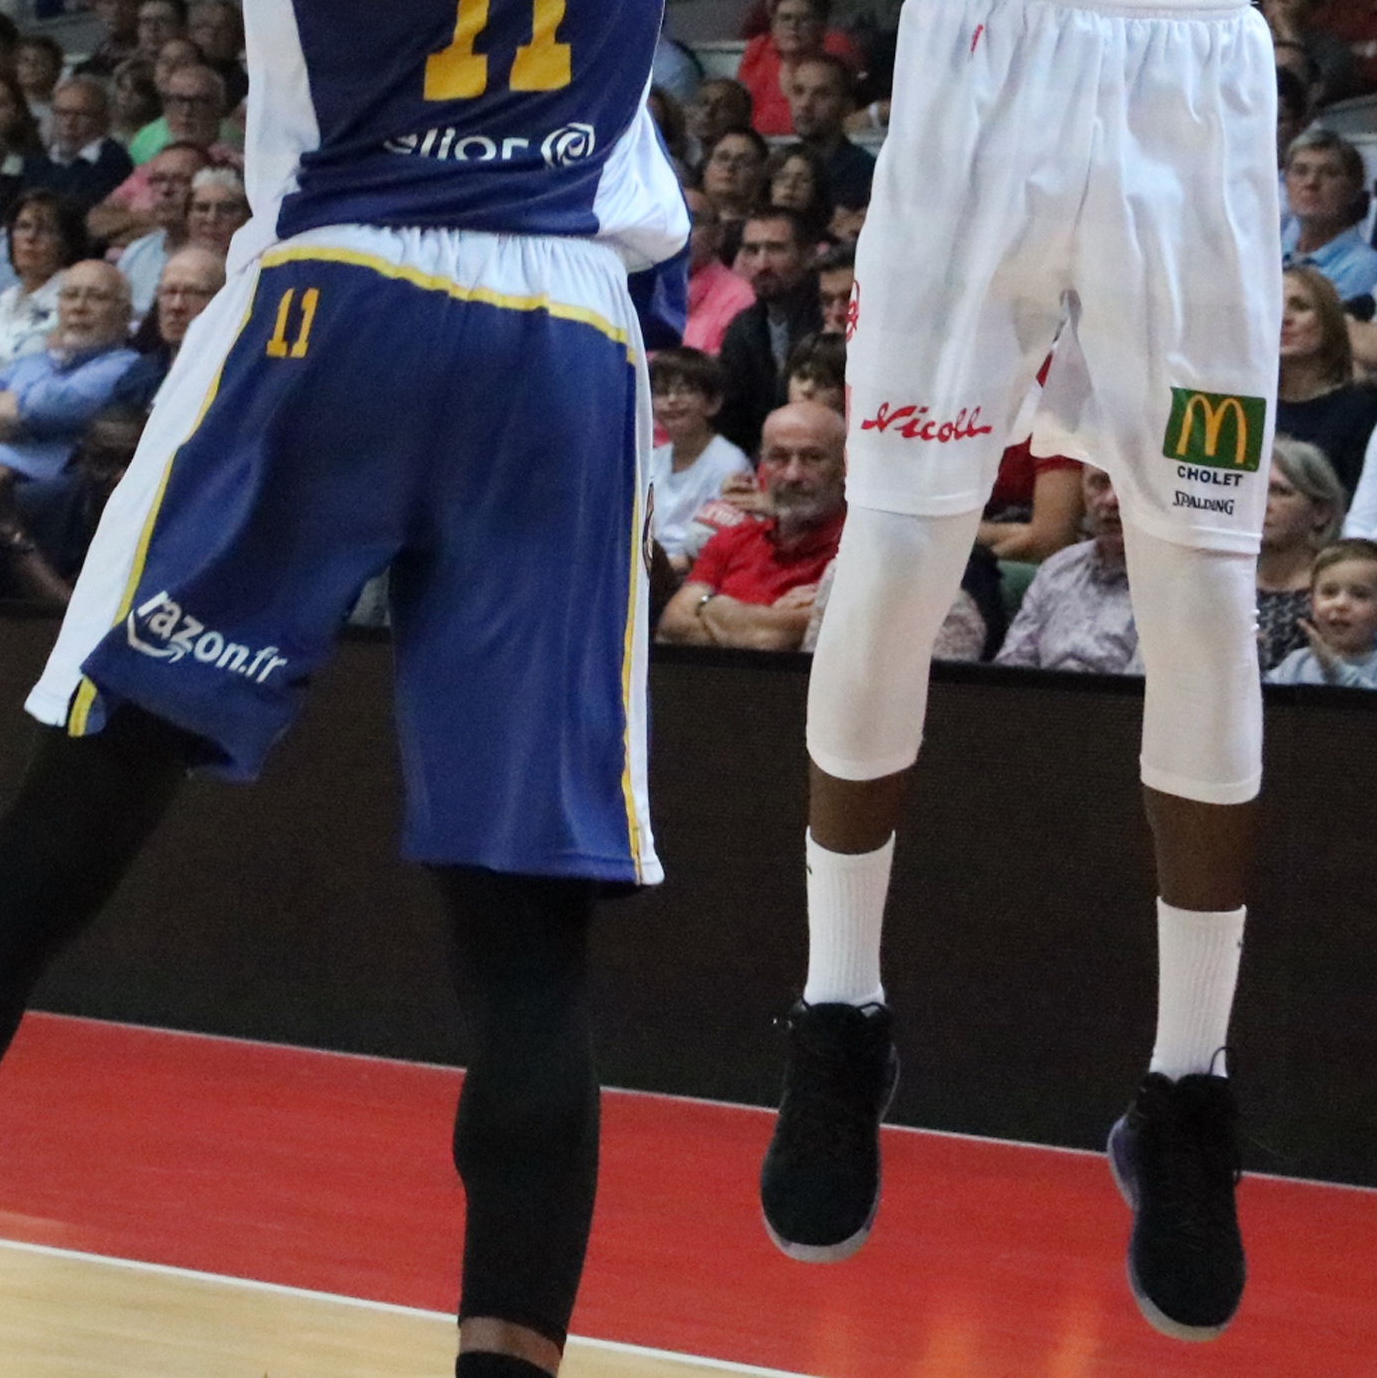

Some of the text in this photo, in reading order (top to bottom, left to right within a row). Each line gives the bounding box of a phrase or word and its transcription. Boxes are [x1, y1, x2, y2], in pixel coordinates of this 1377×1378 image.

[265, 287, 321, 359] 11
[860, 401, 993, 443] Nicoll
[1176, 464, 1244, 488] CHOLET
[1172, 489, 1236, 516] SPALDING
